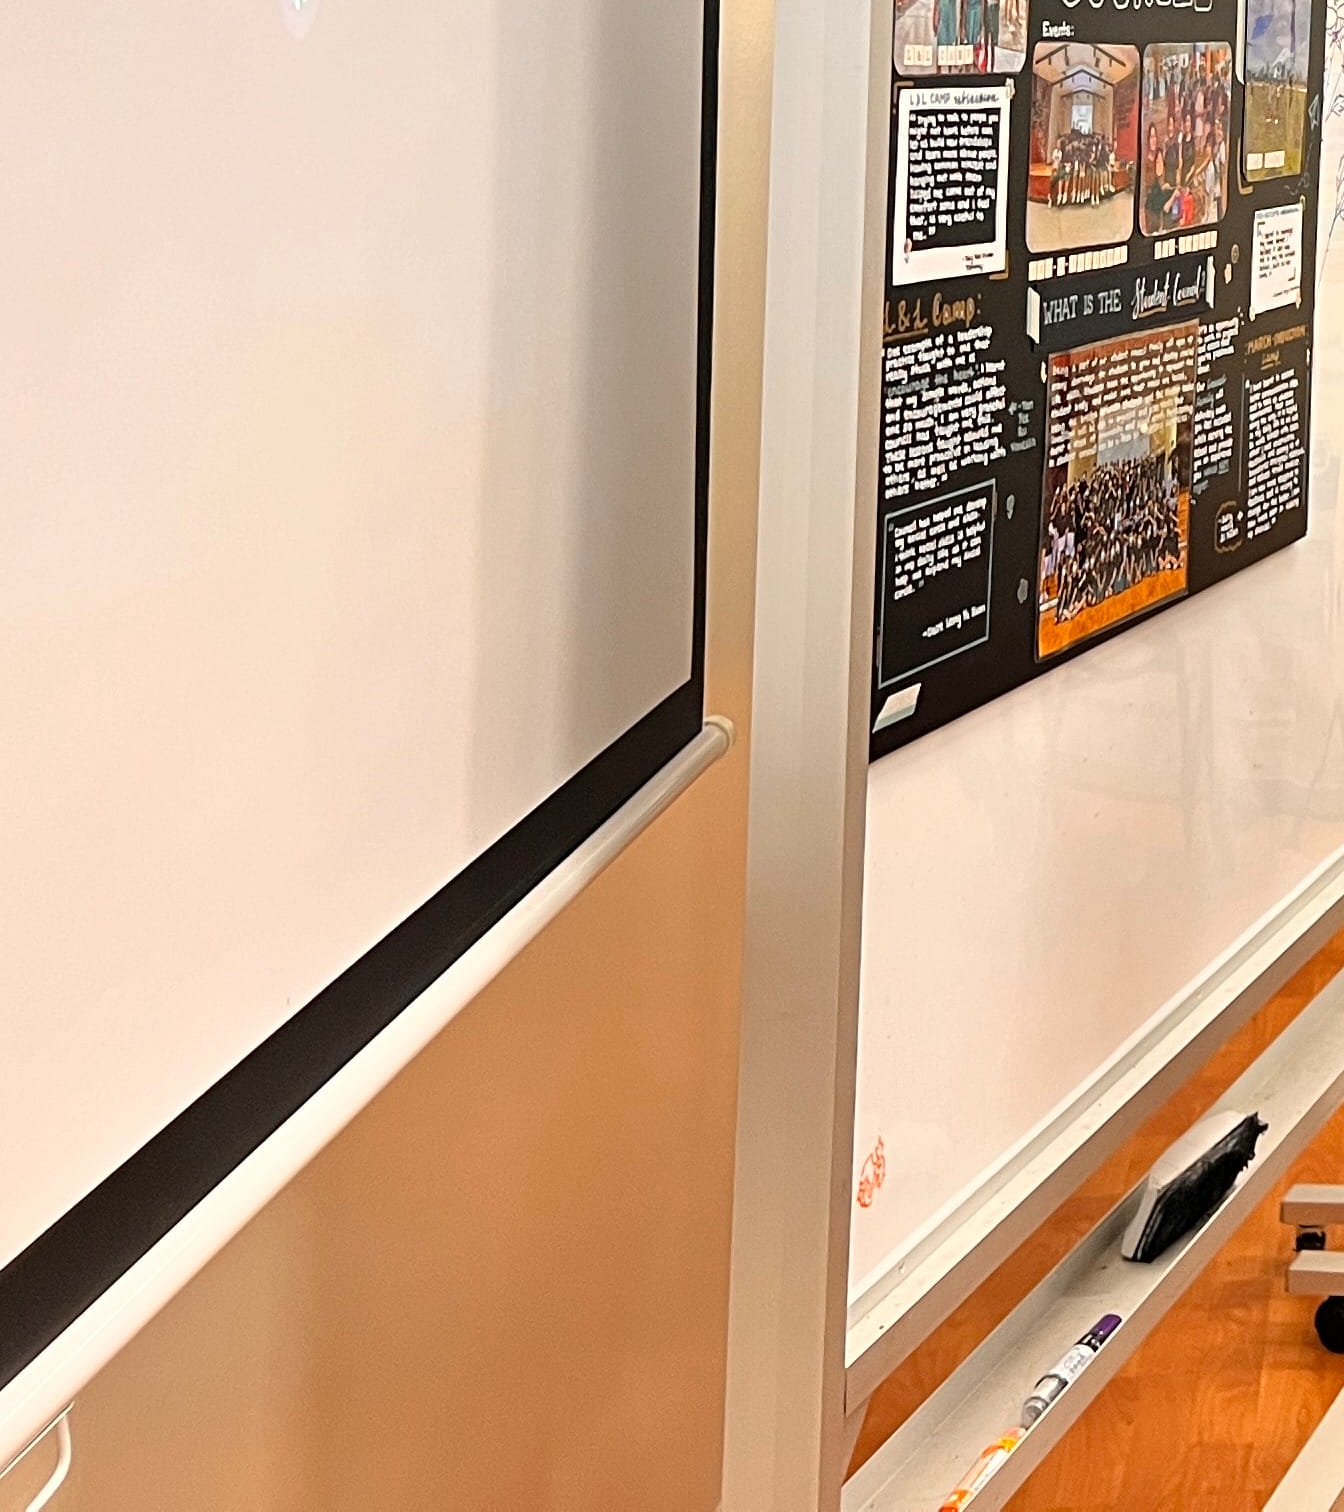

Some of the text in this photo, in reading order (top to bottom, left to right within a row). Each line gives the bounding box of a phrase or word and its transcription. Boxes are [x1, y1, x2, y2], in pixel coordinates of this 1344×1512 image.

[1043, 295, 1078, 325] WHAT
[1083, 294, 1094, 316] IS
[1098, 289, 1121, 315] THE
